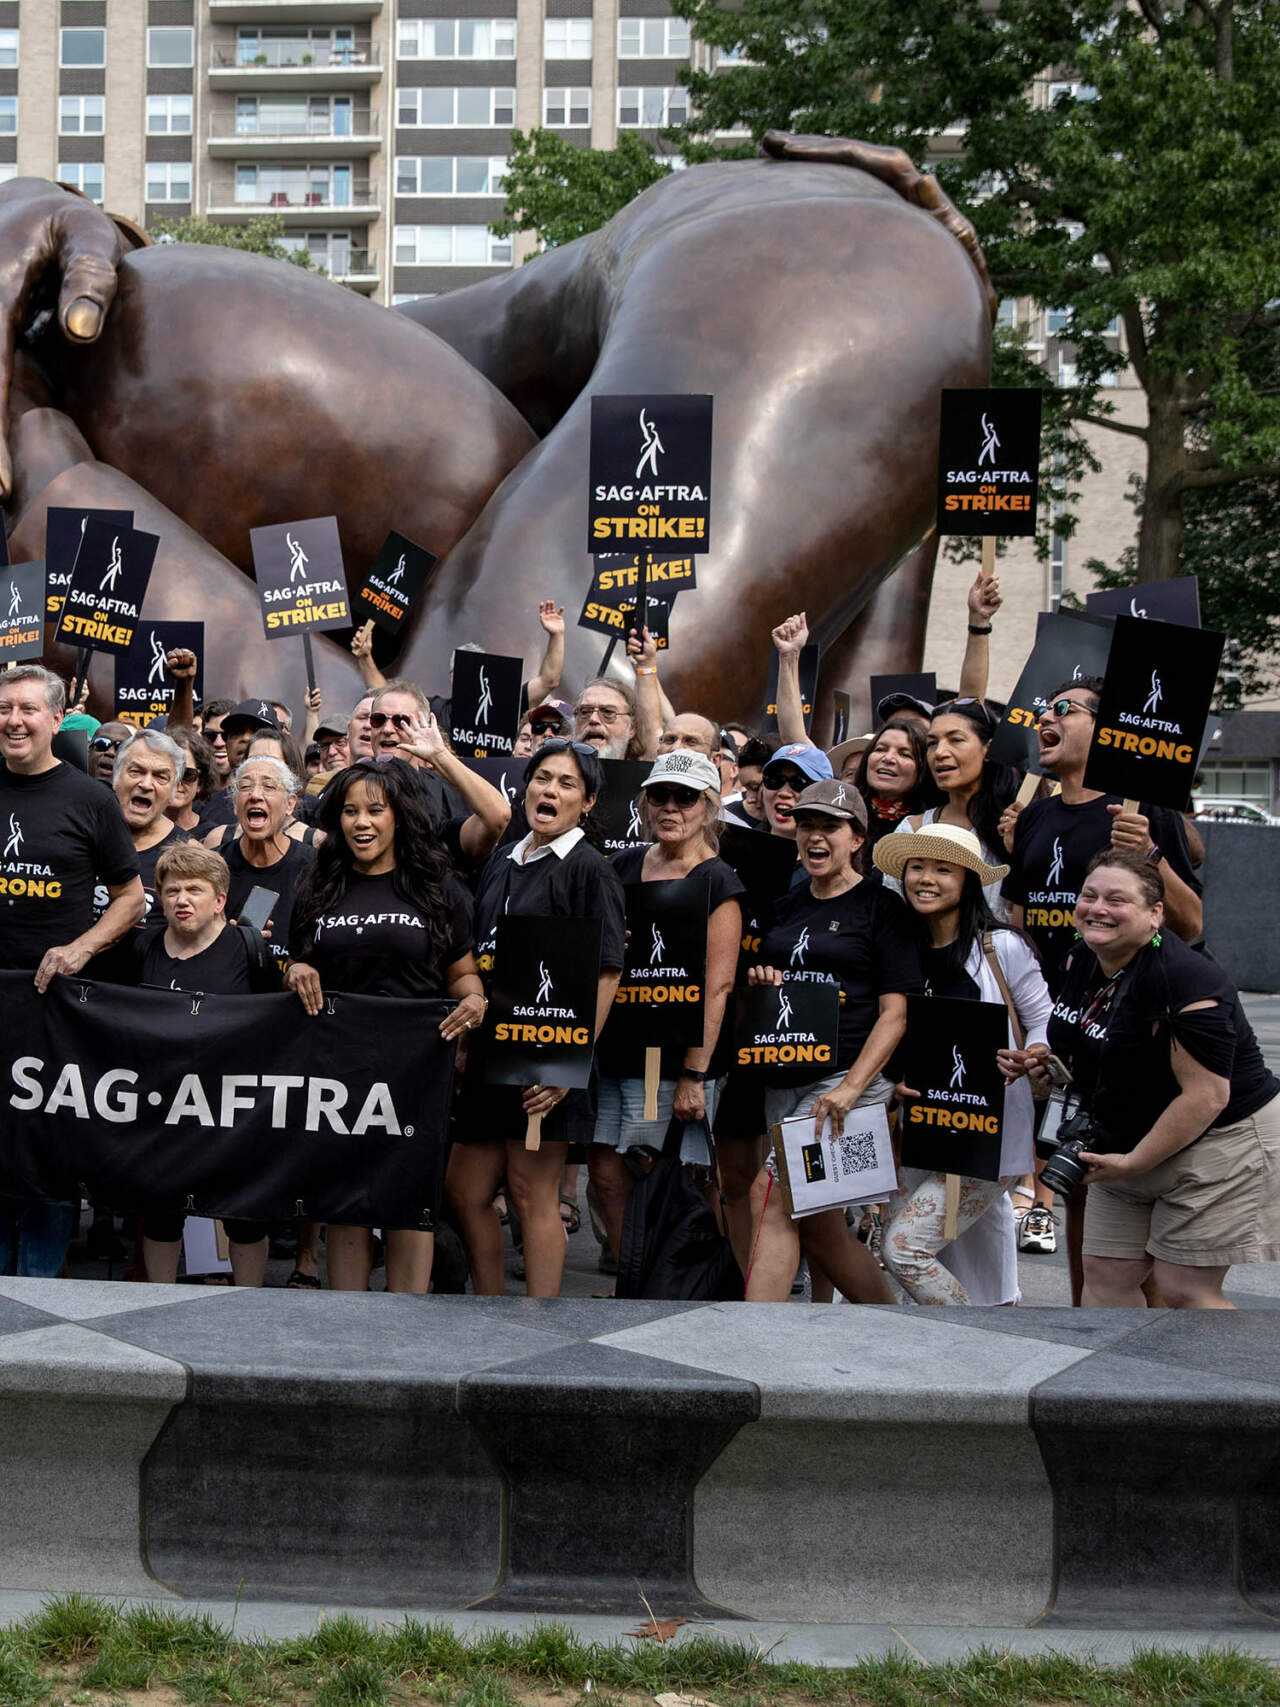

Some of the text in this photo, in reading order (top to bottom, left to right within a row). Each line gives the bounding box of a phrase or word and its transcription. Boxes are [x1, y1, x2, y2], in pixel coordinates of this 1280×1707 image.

[980, 485, 996, 493] ON
[638, 505, 660, 516] ON
[946, 495, 1030, 510] STRIKE!
[594, 517, 704, 538] STRIKE!
[296, 598, 313, 608] ON
[361, 588, 403, 619] STRIKE!
[94, 611, 108, 622] ON
[266, 602, 347, 628] STRIKE!
[62, 615, 132, 646] STRIKE!
[150, 703, 166, 712] ON
[474, 749, 487, 758] ON
[1098, 728, 1192, 763] STRONG
[1028, 909, 1076, 927] STRON
[782, 970, 835, 984] G·AFTRA
[616, 985, 700, 1003] STRONG
[496, 1024, 588, 1044] STRONG
[738, 1045, 830, 1064] STRONG
[910, 1106, 998, 1134] STRONG
